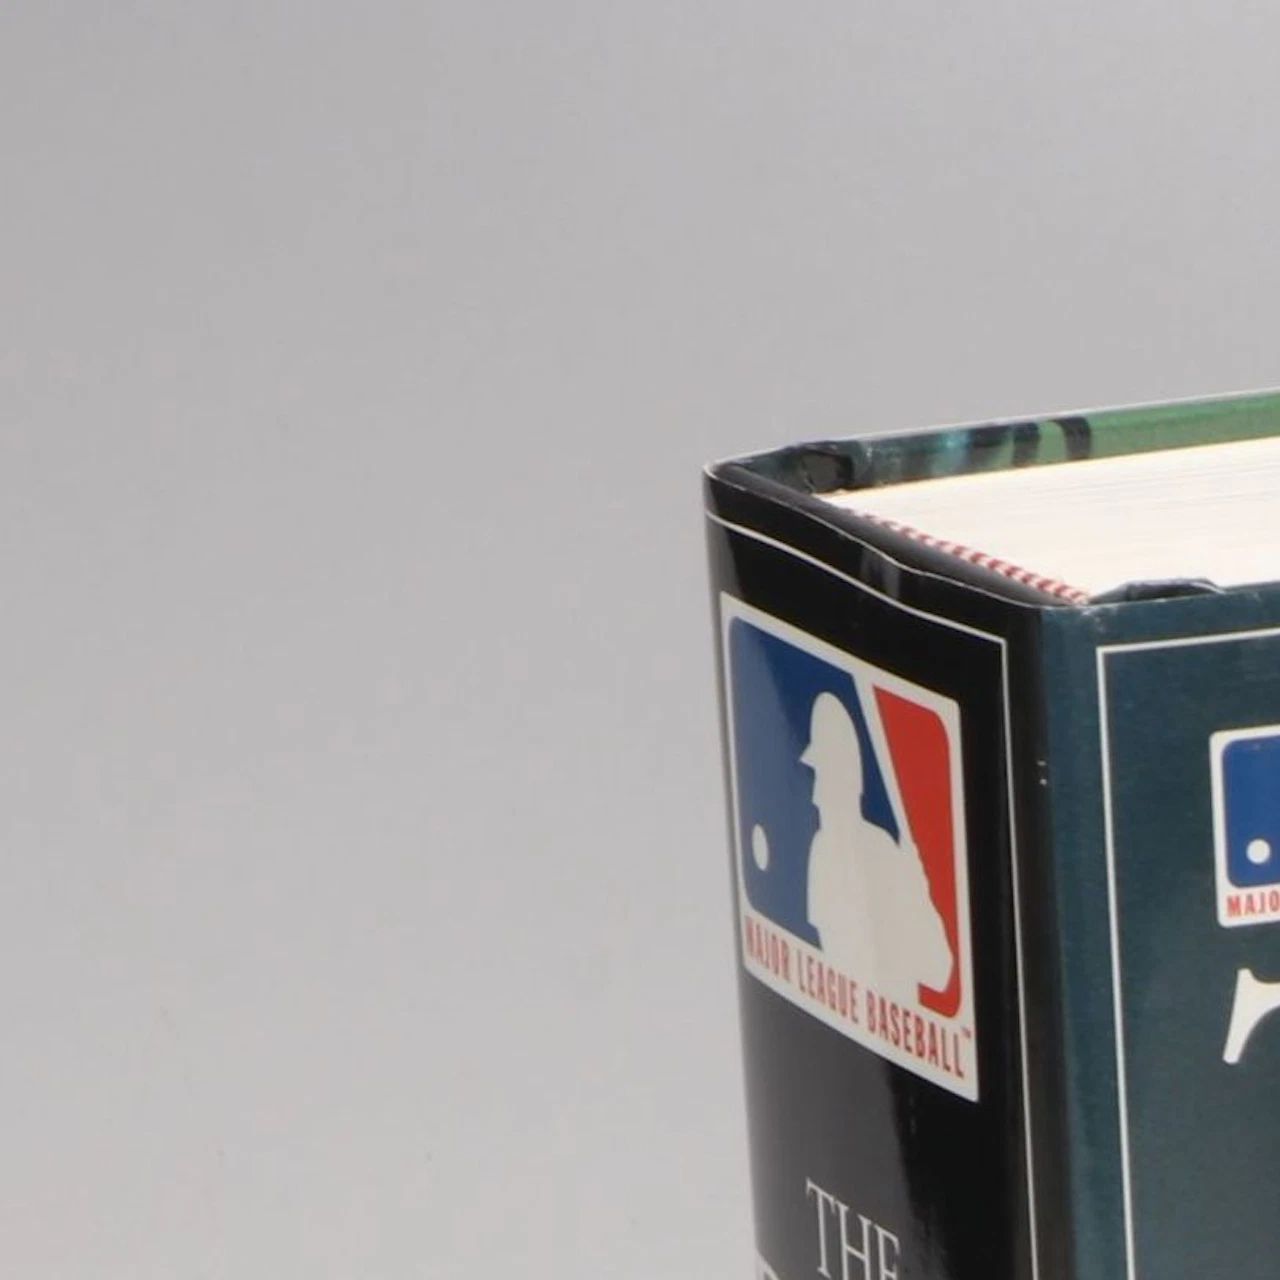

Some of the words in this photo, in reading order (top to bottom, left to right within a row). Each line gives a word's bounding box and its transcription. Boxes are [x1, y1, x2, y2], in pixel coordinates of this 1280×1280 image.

[745, 915, 792, 984] MAJOR
[796, 949, 860, 1023] LEAGUE
[867, 999, 965, 1079] BASEBALL
